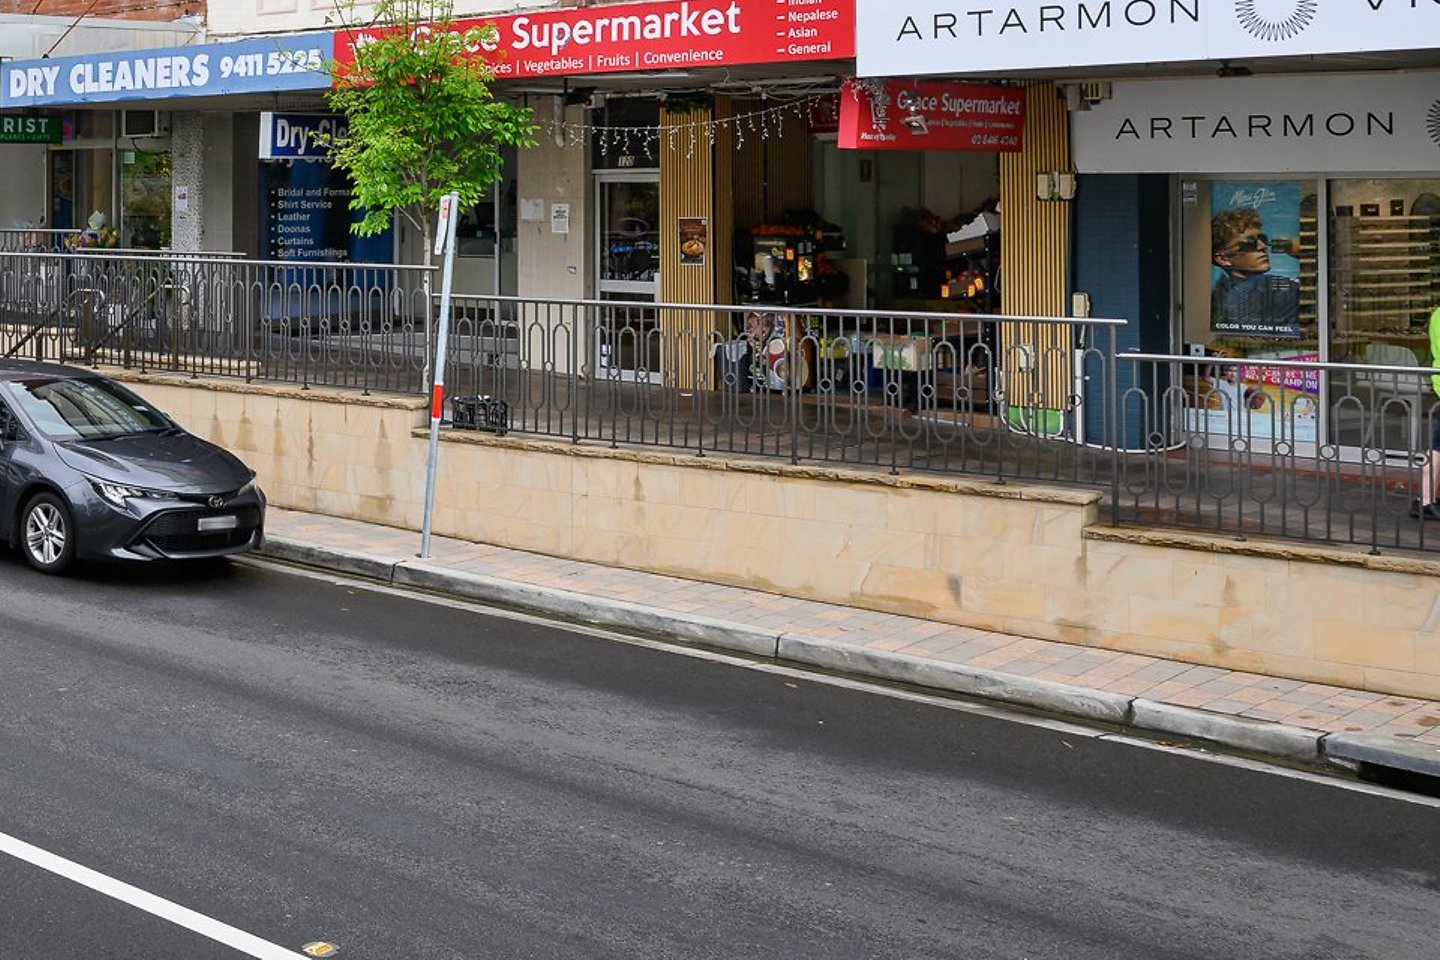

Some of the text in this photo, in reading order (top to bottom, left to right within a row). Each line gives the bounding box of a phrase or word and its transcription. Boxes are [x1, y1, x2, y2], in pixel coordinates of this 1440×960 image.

[788, 9, 839, 23] Nepalese
[512, 0, 742, 55] Supermarket
[788, 26, 818, 39] Asian
[788, 42, 832, 56] General
[523, 56, 584, 74] Vegetables
[597, 54, 631, 68] Fruits
[644, 48, 724, 65] Convenience
[9, 48, 322, 98] DRY CLEANERS 9411 5225
[941, 93, 1021, 117] Supermarket
[1115, 111, 1394, 140] ARTARMON
[276, 119, 310, 155] Dry
[278, 188, 304, 197] Bridal
[305, 188, 322, 197] and
[277, 200, 332, 209] Shirt Service
[277, 212, 311, 221] Leather
[277, 224, 311, 233] Doonas
[277, 236, 314, 246] Curtains
[277, 247, 348, 259] Soft Furnishings
